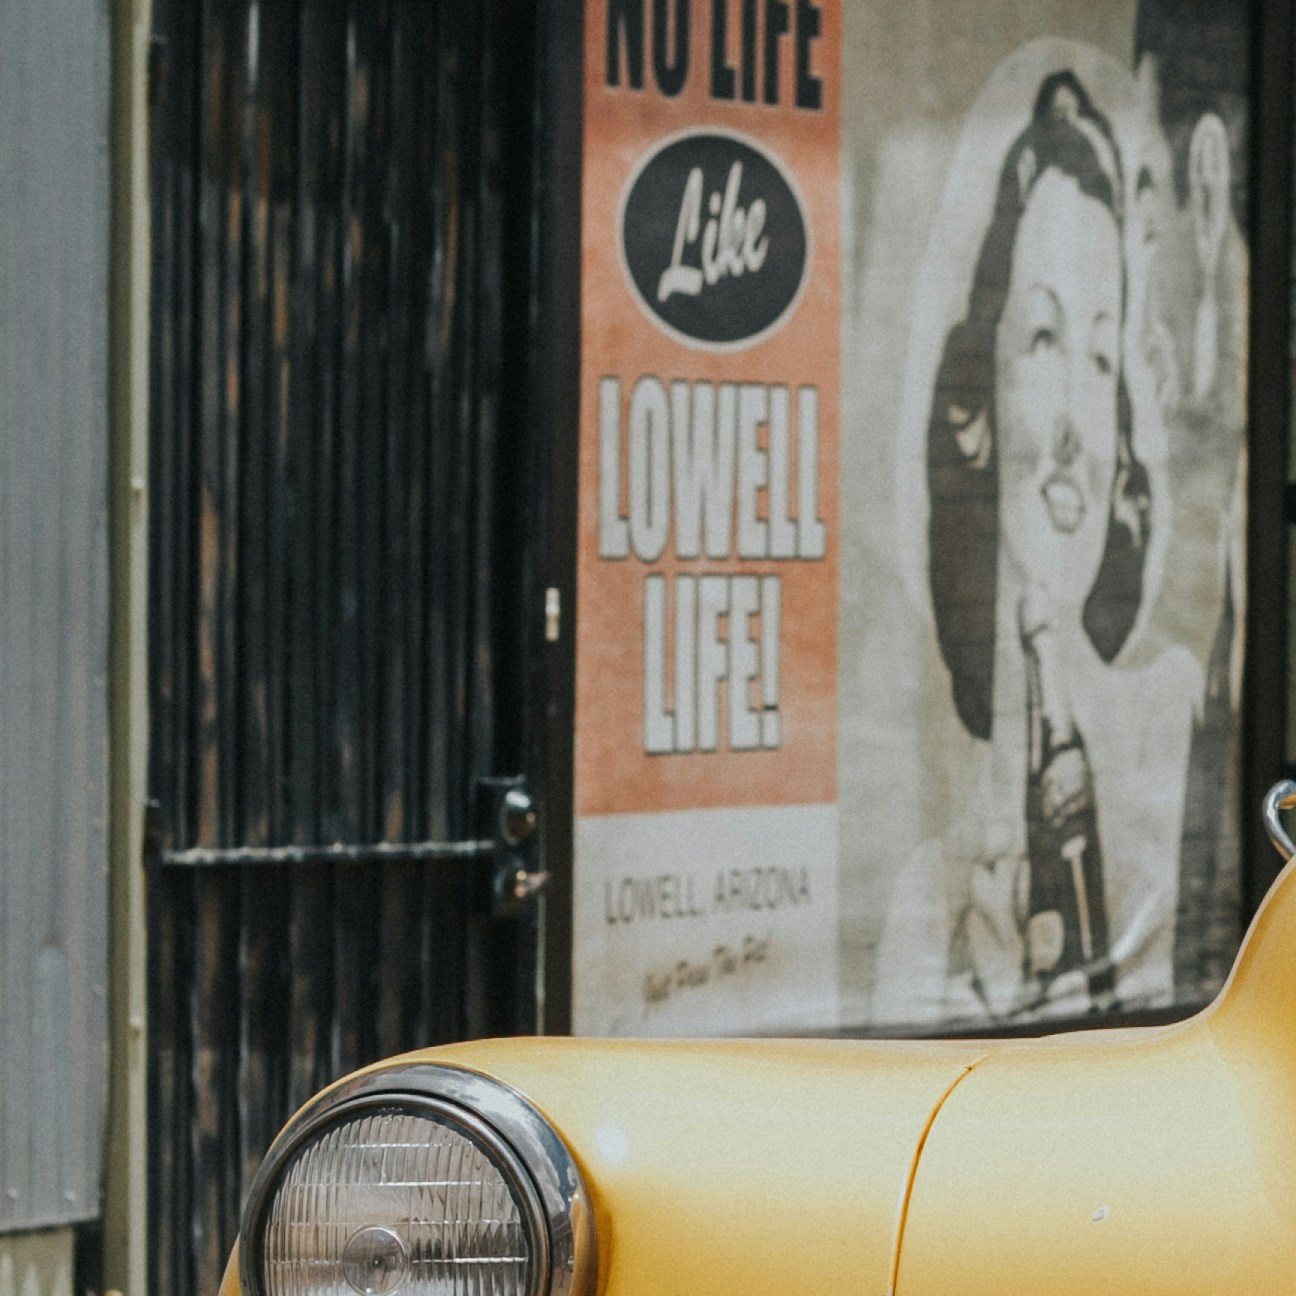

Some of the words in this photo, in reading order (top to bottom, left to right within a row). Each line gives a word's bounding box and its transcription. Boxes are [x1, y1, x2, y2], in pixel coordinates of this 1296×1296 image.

[658, 160, 770, 301] Like
[599, 373, 827, 563] LOWELL
[643, 571, 783, 755] LIFE!
[712, 866, 811, 911] ARIZONA
